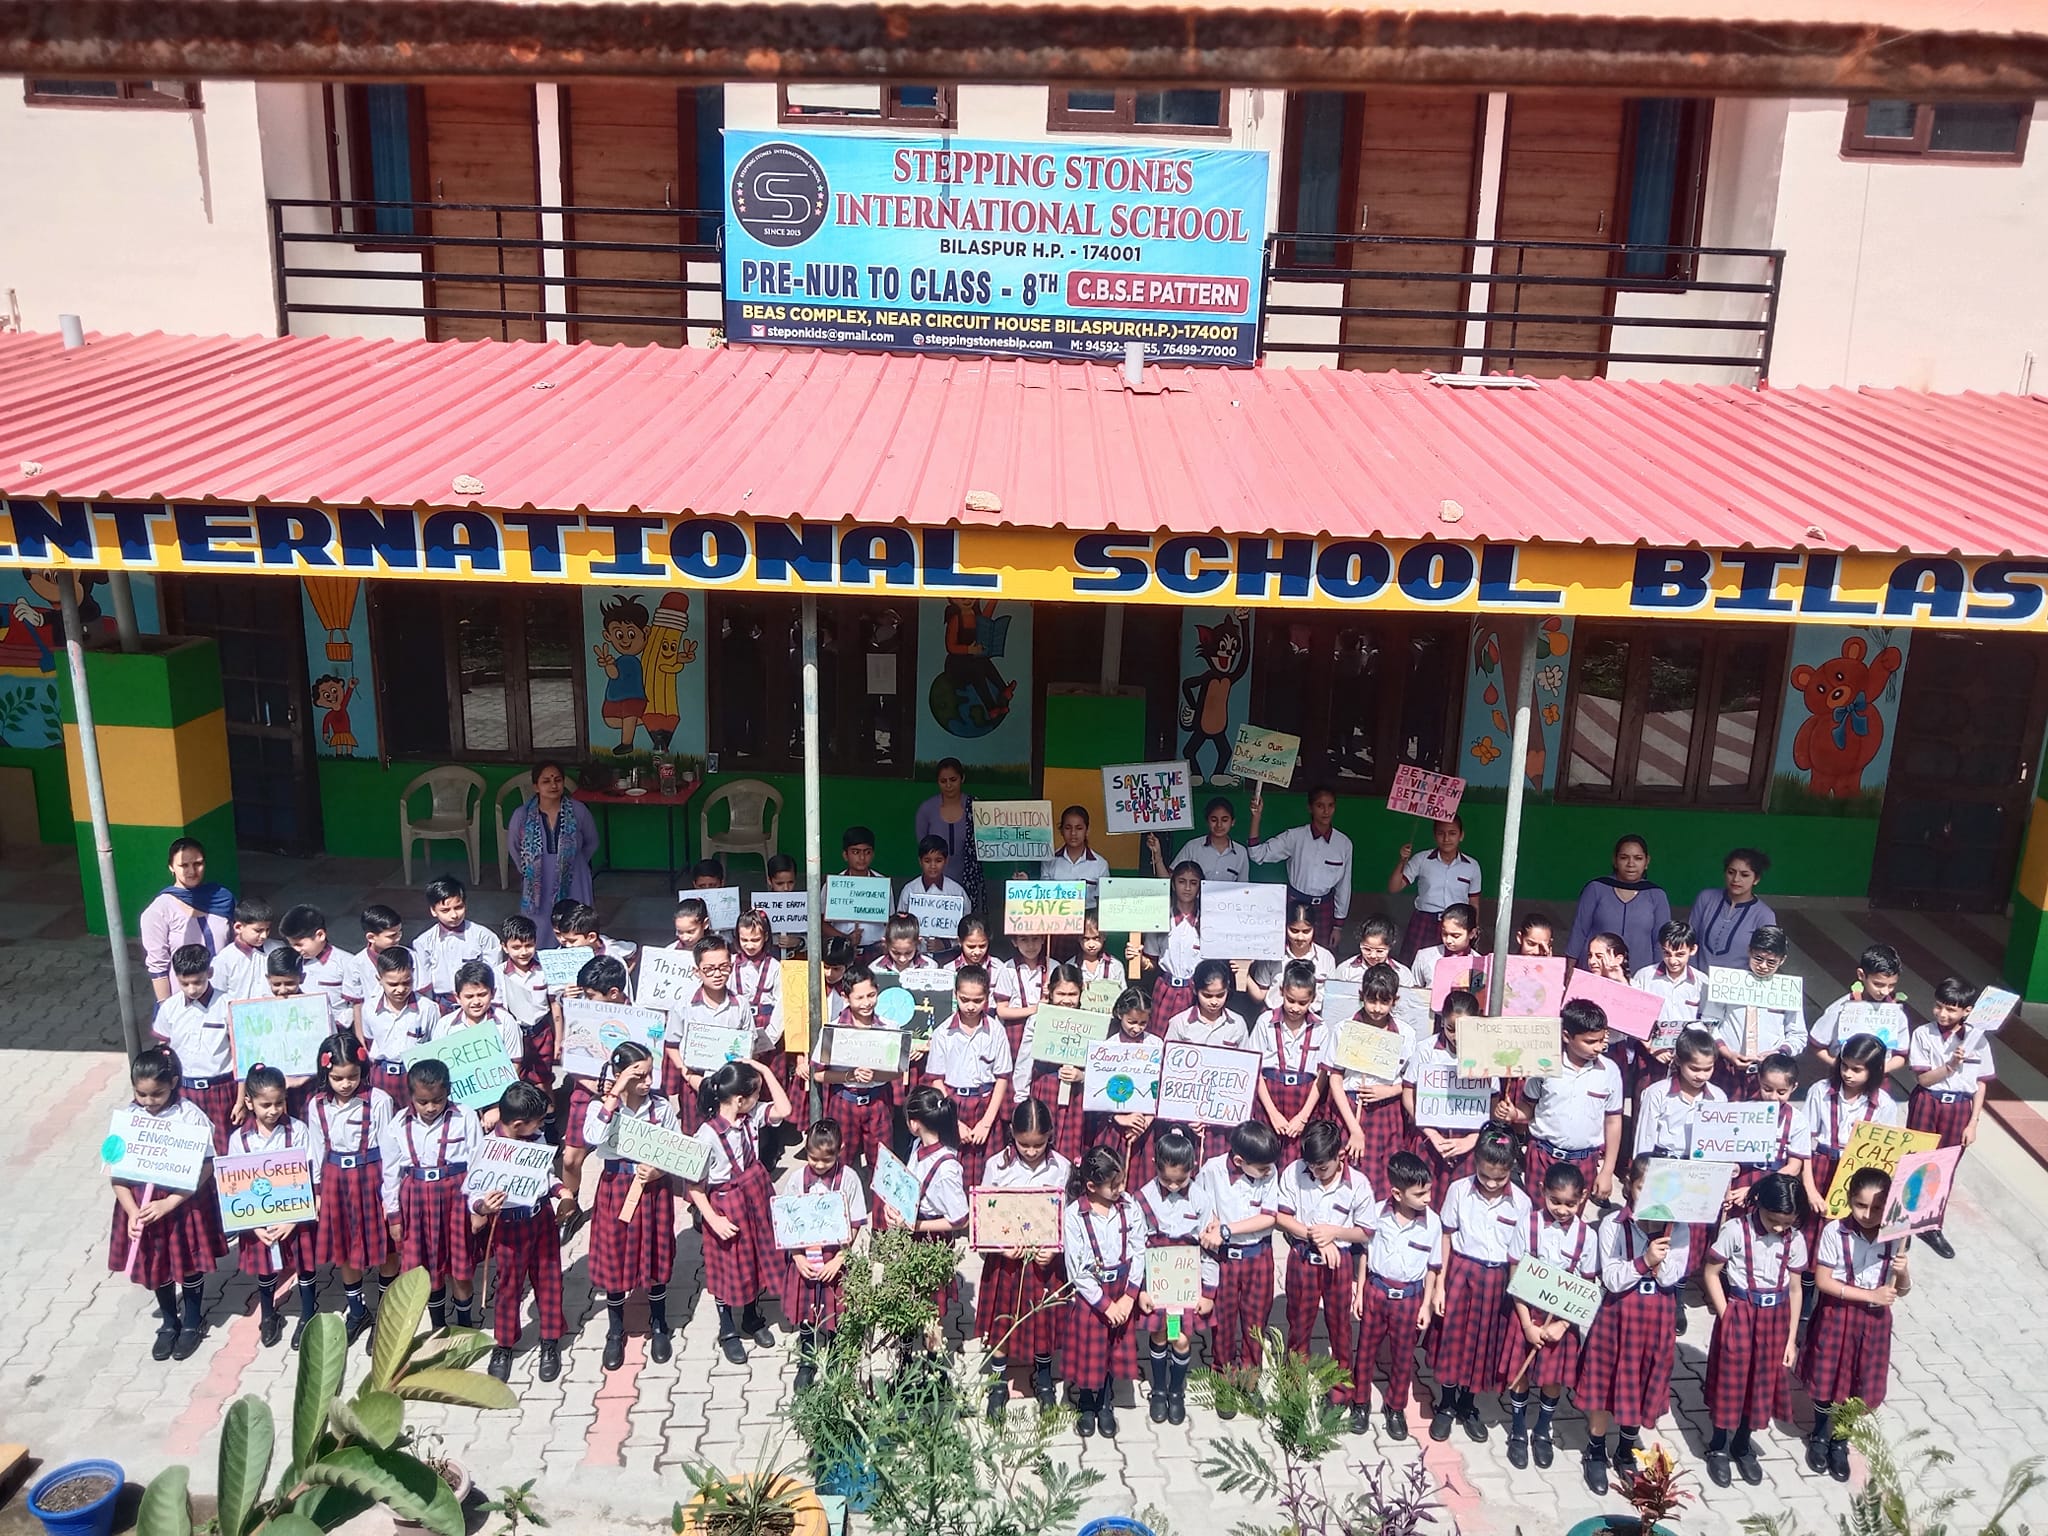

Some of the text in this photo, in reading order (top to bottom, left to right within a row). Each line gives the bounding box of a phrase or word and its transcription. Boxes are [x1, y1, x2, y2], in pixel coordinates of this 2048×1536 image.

[893, 148, 1194, 195] STEPPING STONES
[835, 192, 1250, 243] INTERNATIONAL SCHOOL
[764, 228, 785, 236] SINCE
[940, 238, 1027, 258] BILASPUR
[1032, 243, 1065, 259] H.P.
[1082, 244, 1141, 262] 174001
[742, 260, 859, 299] PRE-NUR
[867, 266, 900, 300] TO
[911, 267, 992, 304] CLASS
[1022, 273, 1059, 307] 8TH
[1077, 278, 1239, 306] C.B.S.E PATTERN
[743, 305, 1239, 341] BEAS COMPLEX, NEAR CIRCUIT HOUSE BILASPUR(H.P.)-174001
[767, 327, 895, 344] steponkids@gmail.com
[1070, 339, 1083, 351] M:
[1163, 343, 1237, 357] 76499-77000
[1072, 533, 1564, 608] SCHOOL
[1237, 729, 1249, 744] It
[1252, 738, 1262, 747] is
[1113, 770, 1183, 789] SAVE THE
[1400, 766, 1461, 788] BETTER
[1115, 795, 1186, 812] SECURE THE
[1396, 786, 1445, 807] BETTER
[994, 807, 1050, 827] POLLUTION
[1133, 808, 1181, 824] FUTURE
[1391, 796, 1456, 820] TOMORROW
[976, 840, 1055, 858] BEST SOLUTION
[1008, 887, 1033, 900] SAVE
[1032, 884, 1052, 900] THE
[786, 900, 806, 909] EARTH
[910, 897, 962, 911] THINK GREEN
[1023, 900, 1072, 915] SAVE
[931, 917, 958, 929] GREEN
[654, 958, 694, 981] Think
[1713, 969, 1741, 985] GO
[653, 983, 666, 999] be
[1476, 1022, 1503, 1034] MORE
[437, 1035, 502, 1069] GREEN
[1172, 1049, 1199, 1068] GO
[475, 1064, 517, 1090] CLEAN
[1201, 1069, 1248, 1089] GREEN
[1424, 1070, 1457, 1088] KEEP
[1165, 1080, 1216, 1101] BREATHE
[1198, 1101, 1246, 1122] CLEAN
[1421, 1097, 1487, 1116] GO GREEN
[130, 1115, 172, 1132] BETTER
[1701, 1110, 1775, 1124] SAVE TREE
[613, 1113, 708, 1158] THINK GREEN
[1854, 1124, 1914, 1146] KEEP
[127, 1142, 168, 1157] BETTER
[481, 1138, 554, 1169] THINK GREEN
[1697, 1139, 1777, 1152] SAVE EARTH
[136, 1158, 192, 1174] TOMORROW
[638, 1142, 700, 1175] GREEN
[217, 1159, 309, 1183] THINK GREEN
[468, 1169, 541, 1197] GO GREEN
[261, 1194, 310, 1214] GREEN
[1151, 1250, 1168, 1263] NO
[1174, 1256, 1196, 1270] AIR
[1152, 1278, 1169, 1292] NO
[1527, 1263, 1598, 1303] NO WATER
[1177, 1289, 1197, 1302] LIFE
[1539, 1289, 1590, 1319] NO LIFE
